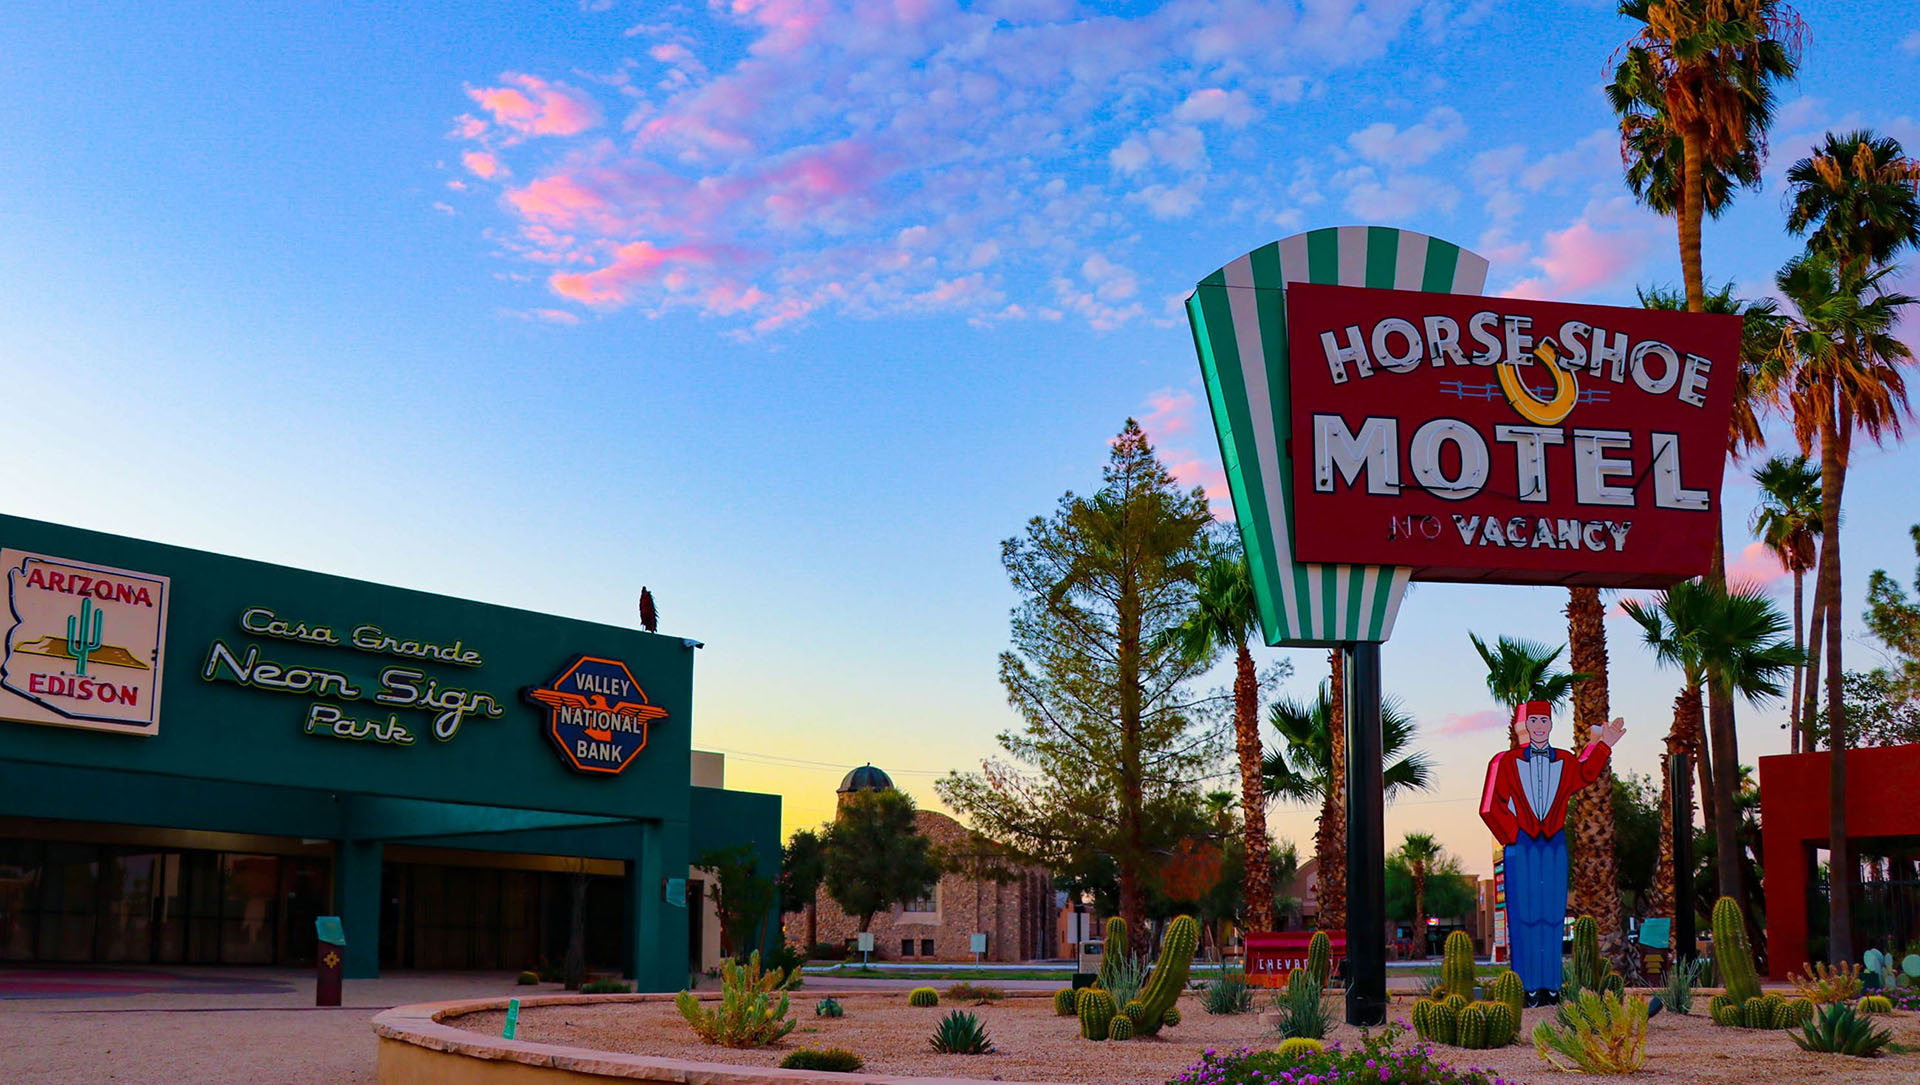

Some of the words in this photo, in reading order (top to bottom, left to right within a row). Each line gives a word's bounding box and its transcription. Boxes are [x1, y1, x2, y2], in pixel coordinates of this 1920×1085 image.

[1319, 311, 1534, 385] HORSE
[1558, 320, 1713, 408] SHOE
[1313, 413, 1710, 511] MOTEL
[1388, 515, 1442, 541] NO
[1452, 514, 1632, 552] VACANCY
[27, 568, 153, 607] ARIZONA
[241, 607, 340, 645] Casa
[351, 625, 484, 666] Grande
[28, 672, 139, 706] EDISON
[203, 641, 361, 698] Neon
[375, 668, 505, 740] Sign
[575, 672, 631, 697] VALLEY
[306, 704, 416, 744] Park
[560, 705, 641, 734] NATIONAL
[576, 739, 623, 763] BANK
[1258, 958, 1334, 970] CHEVROT
